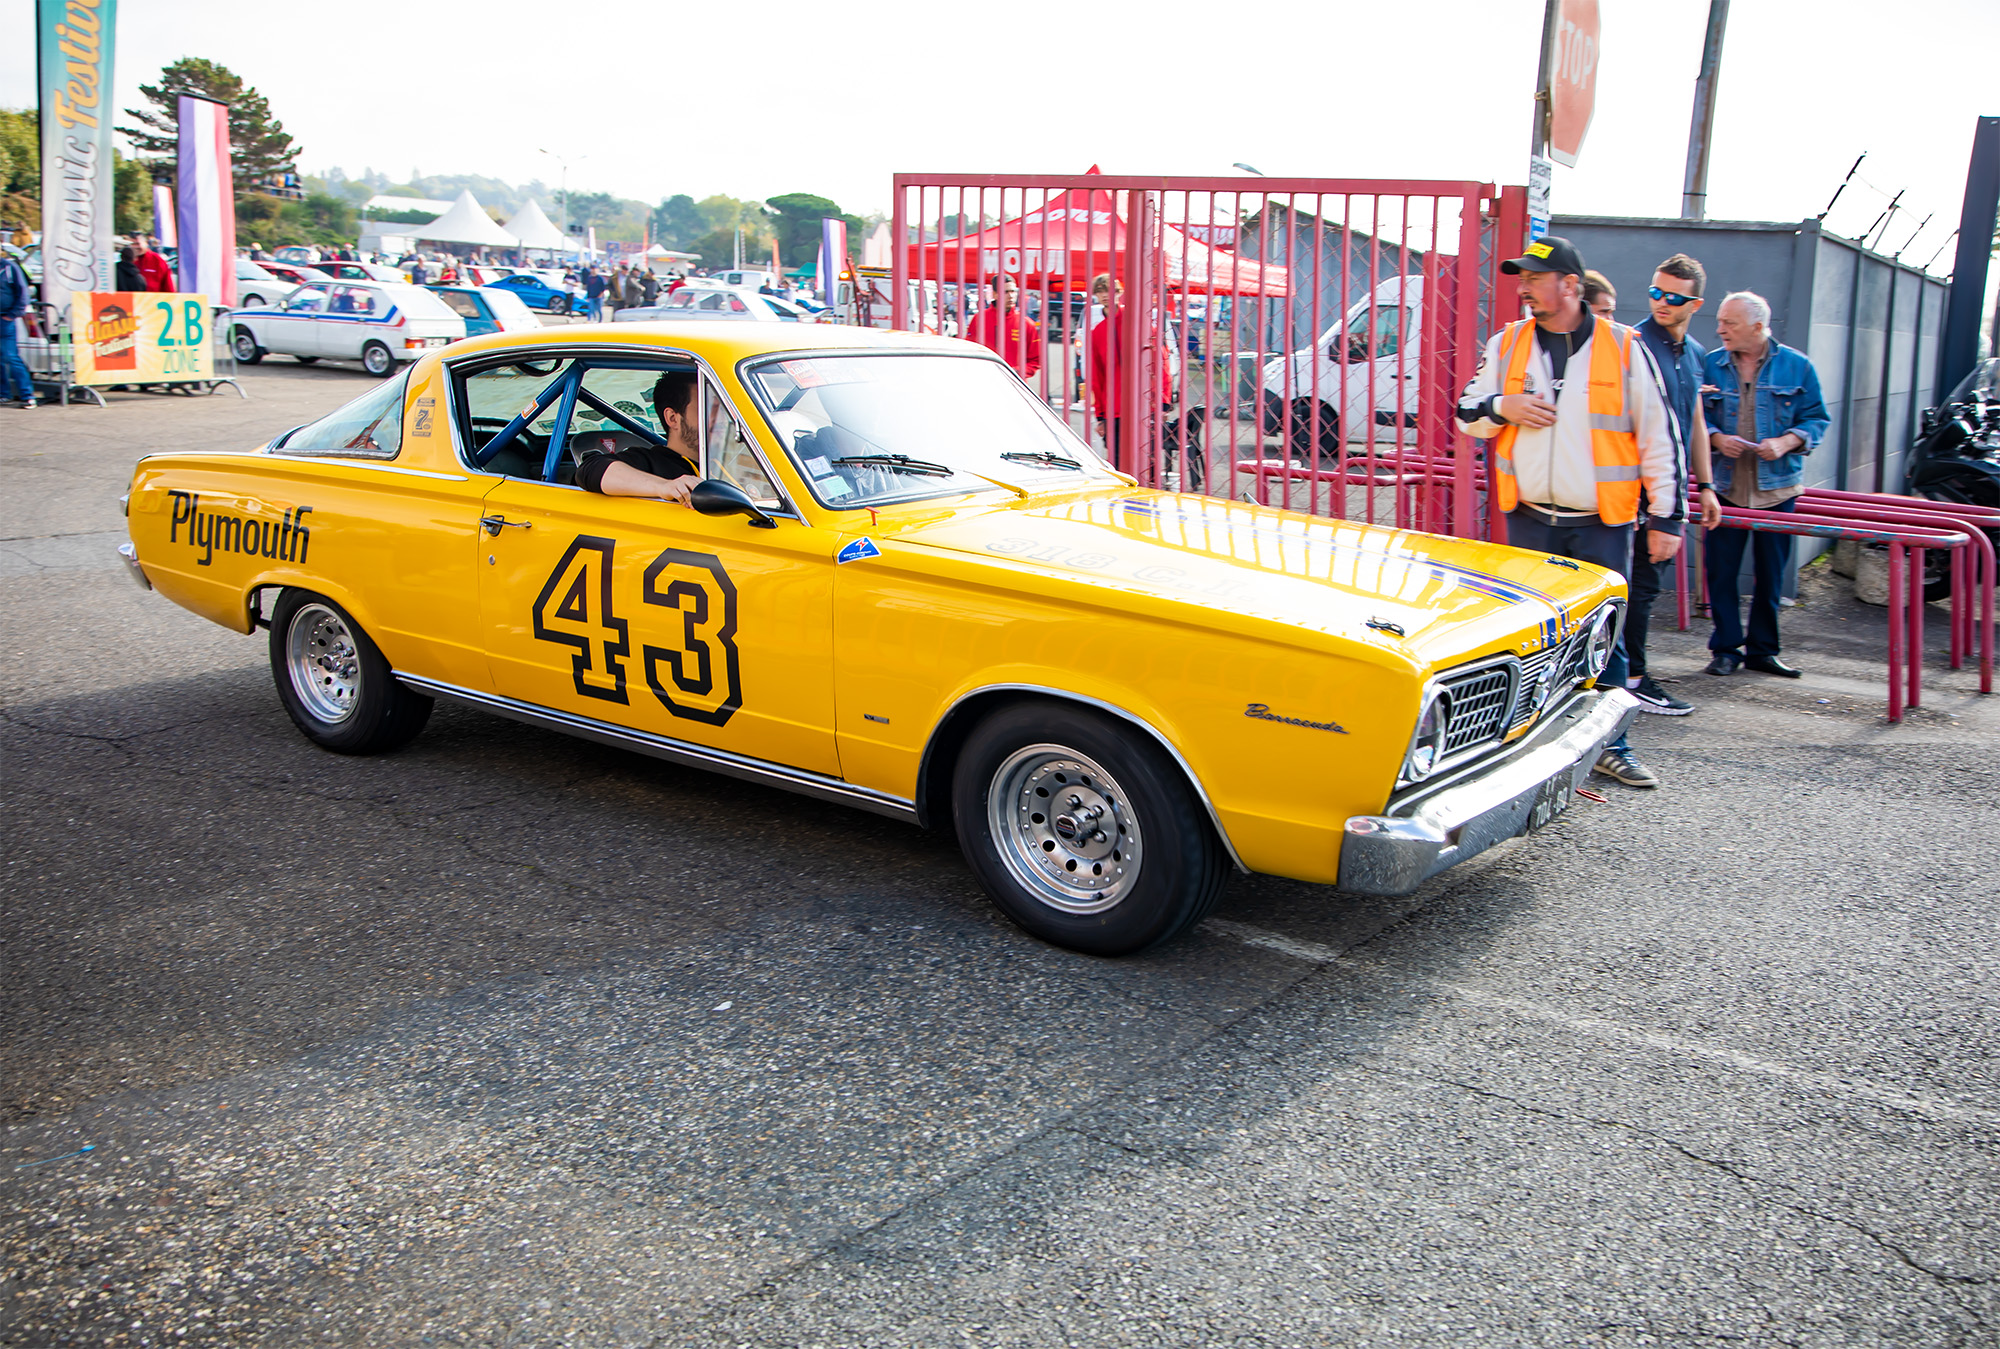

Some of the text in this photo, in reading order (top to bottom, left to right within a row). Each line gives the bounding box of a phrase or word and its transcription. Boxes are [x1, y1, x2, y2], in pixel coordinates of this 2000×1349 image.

[54, 135, 98, 292] Classic
[157, 300, 204, 346] 2.B
[162, 348, 200, 374] ZONE
[168, 489, 313, 567] Plymouth
[985, 537, 1118, 569] 318
[532, 534, 743, 728] 43
[1244, 703, 1350, 735] Barracuda
